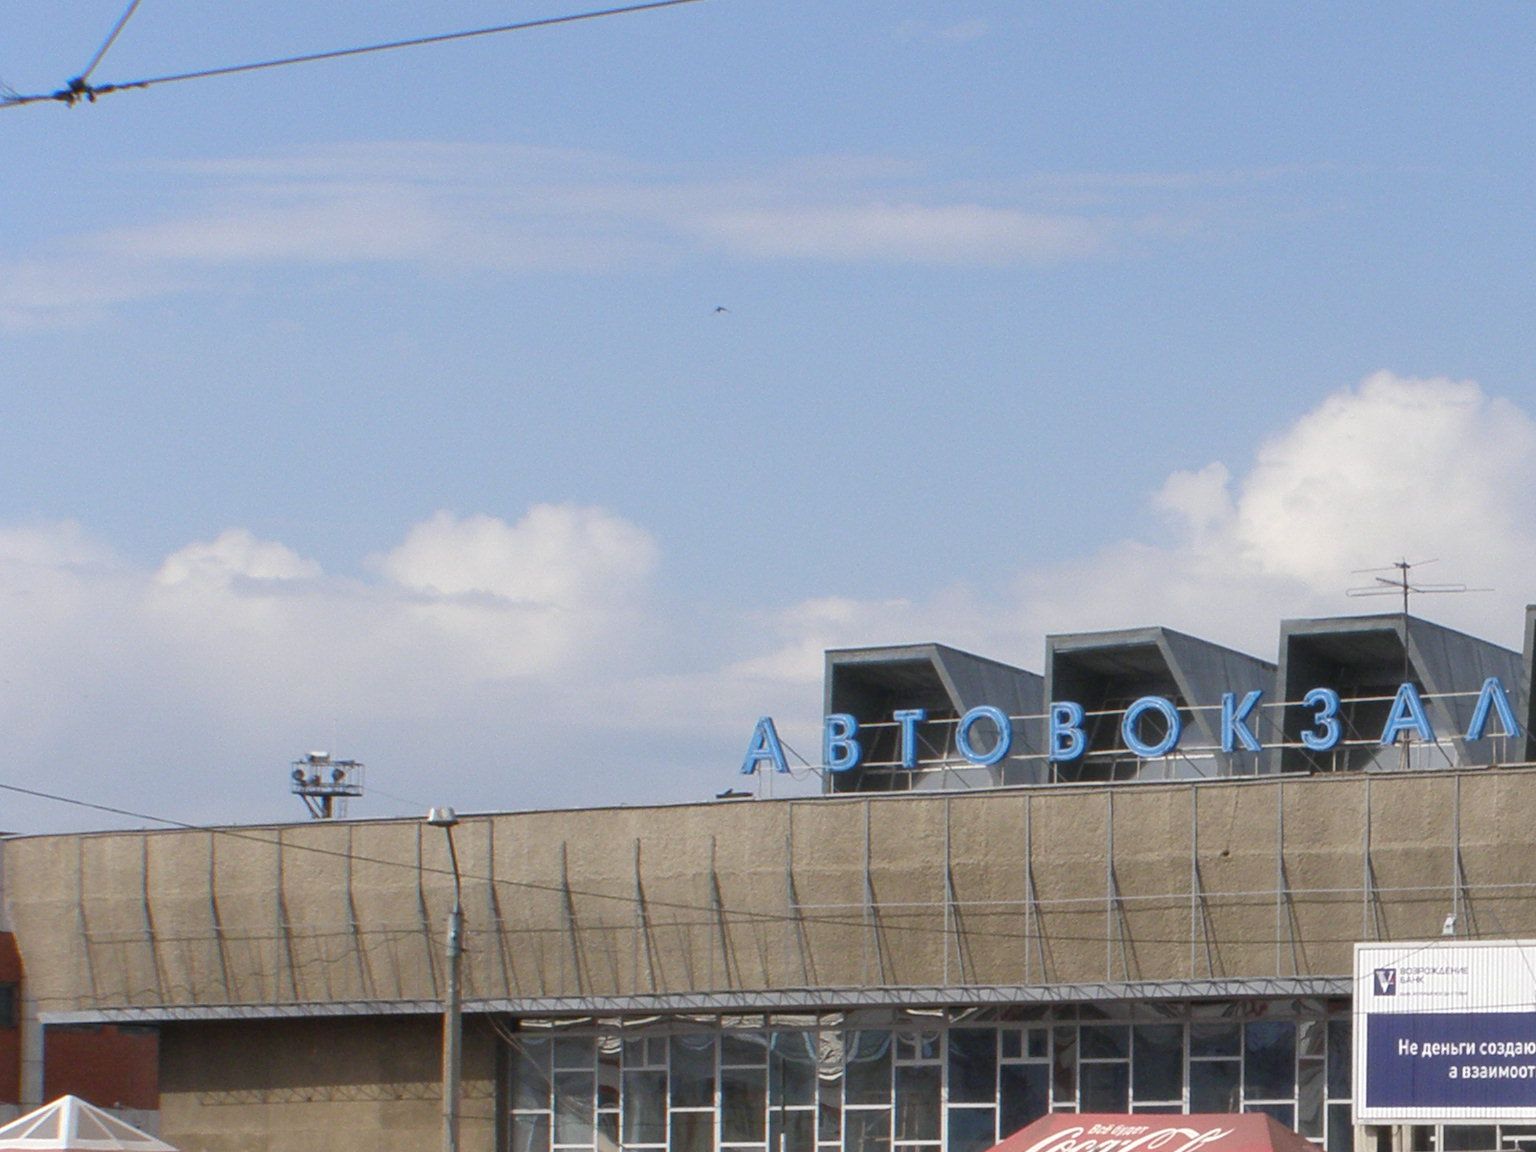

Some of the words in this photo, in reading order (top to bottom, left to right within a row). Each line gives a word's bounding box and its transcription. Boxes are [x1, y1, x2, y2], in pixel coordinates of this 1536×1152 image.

[739, 676, 1522, 776] АВТОВОКЗАЛ
[1399, 966, 1469, 975] ВОЗРОЖДЕНИЕ
[1399, 976, 1424, 984] БАНК
[1398, 1038, 1418, 1056] Не
[1421, 1040, 1476, 1058] деньги
[1449, 1066, 1458, 1079] а
